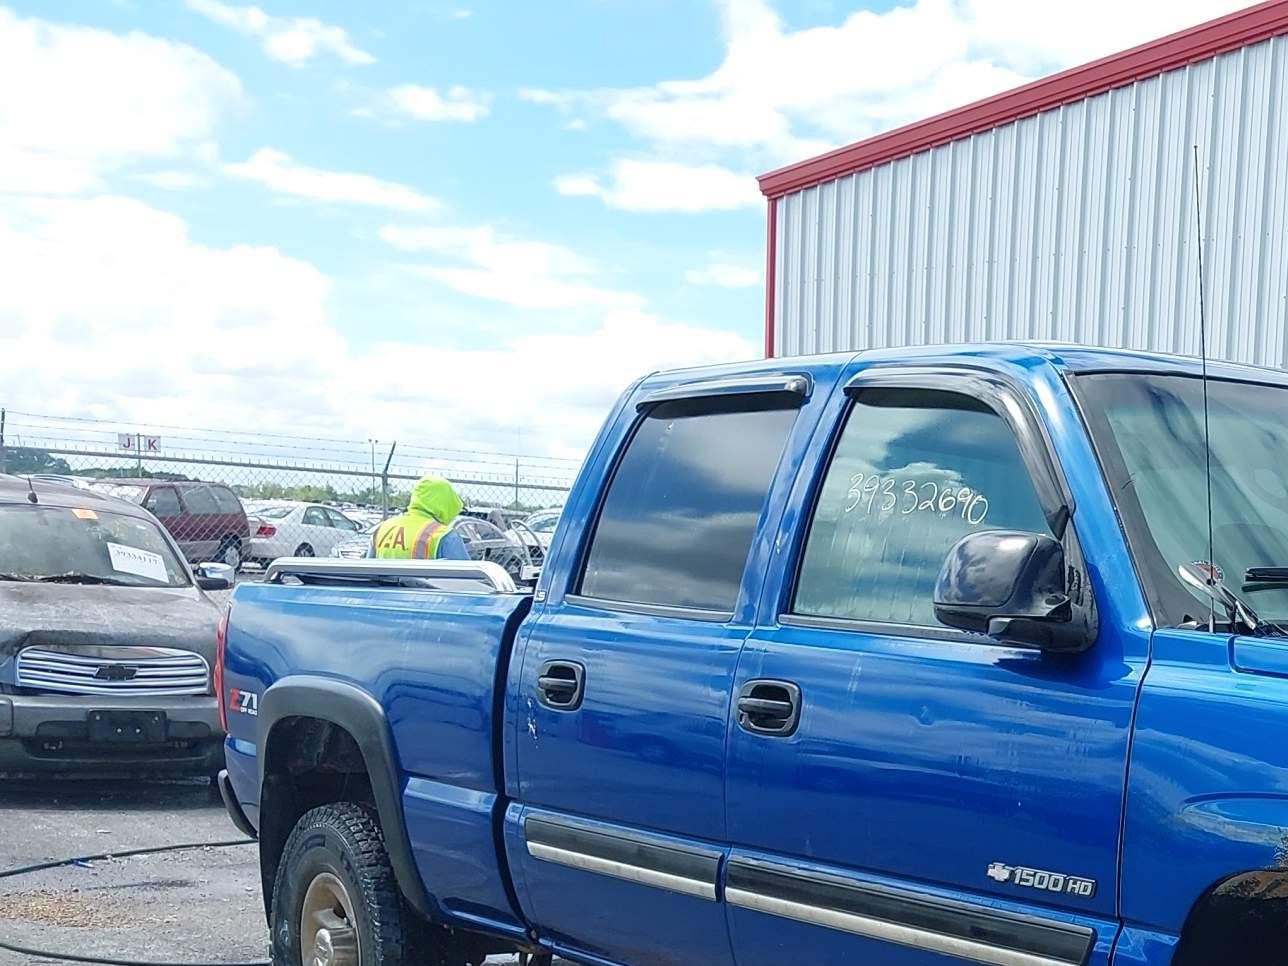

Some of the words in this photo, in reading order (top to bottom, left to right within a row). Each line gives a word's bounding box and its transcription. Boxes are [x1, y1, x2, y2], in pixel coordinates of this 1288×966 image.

[123, 437, 131, 449] J
[148, 439, 158, 450] K
[845, 473, 989, 525] 39332690
[1013, 868, 1064, 892] 1500
[1067, 879, 1093, 896] HD
